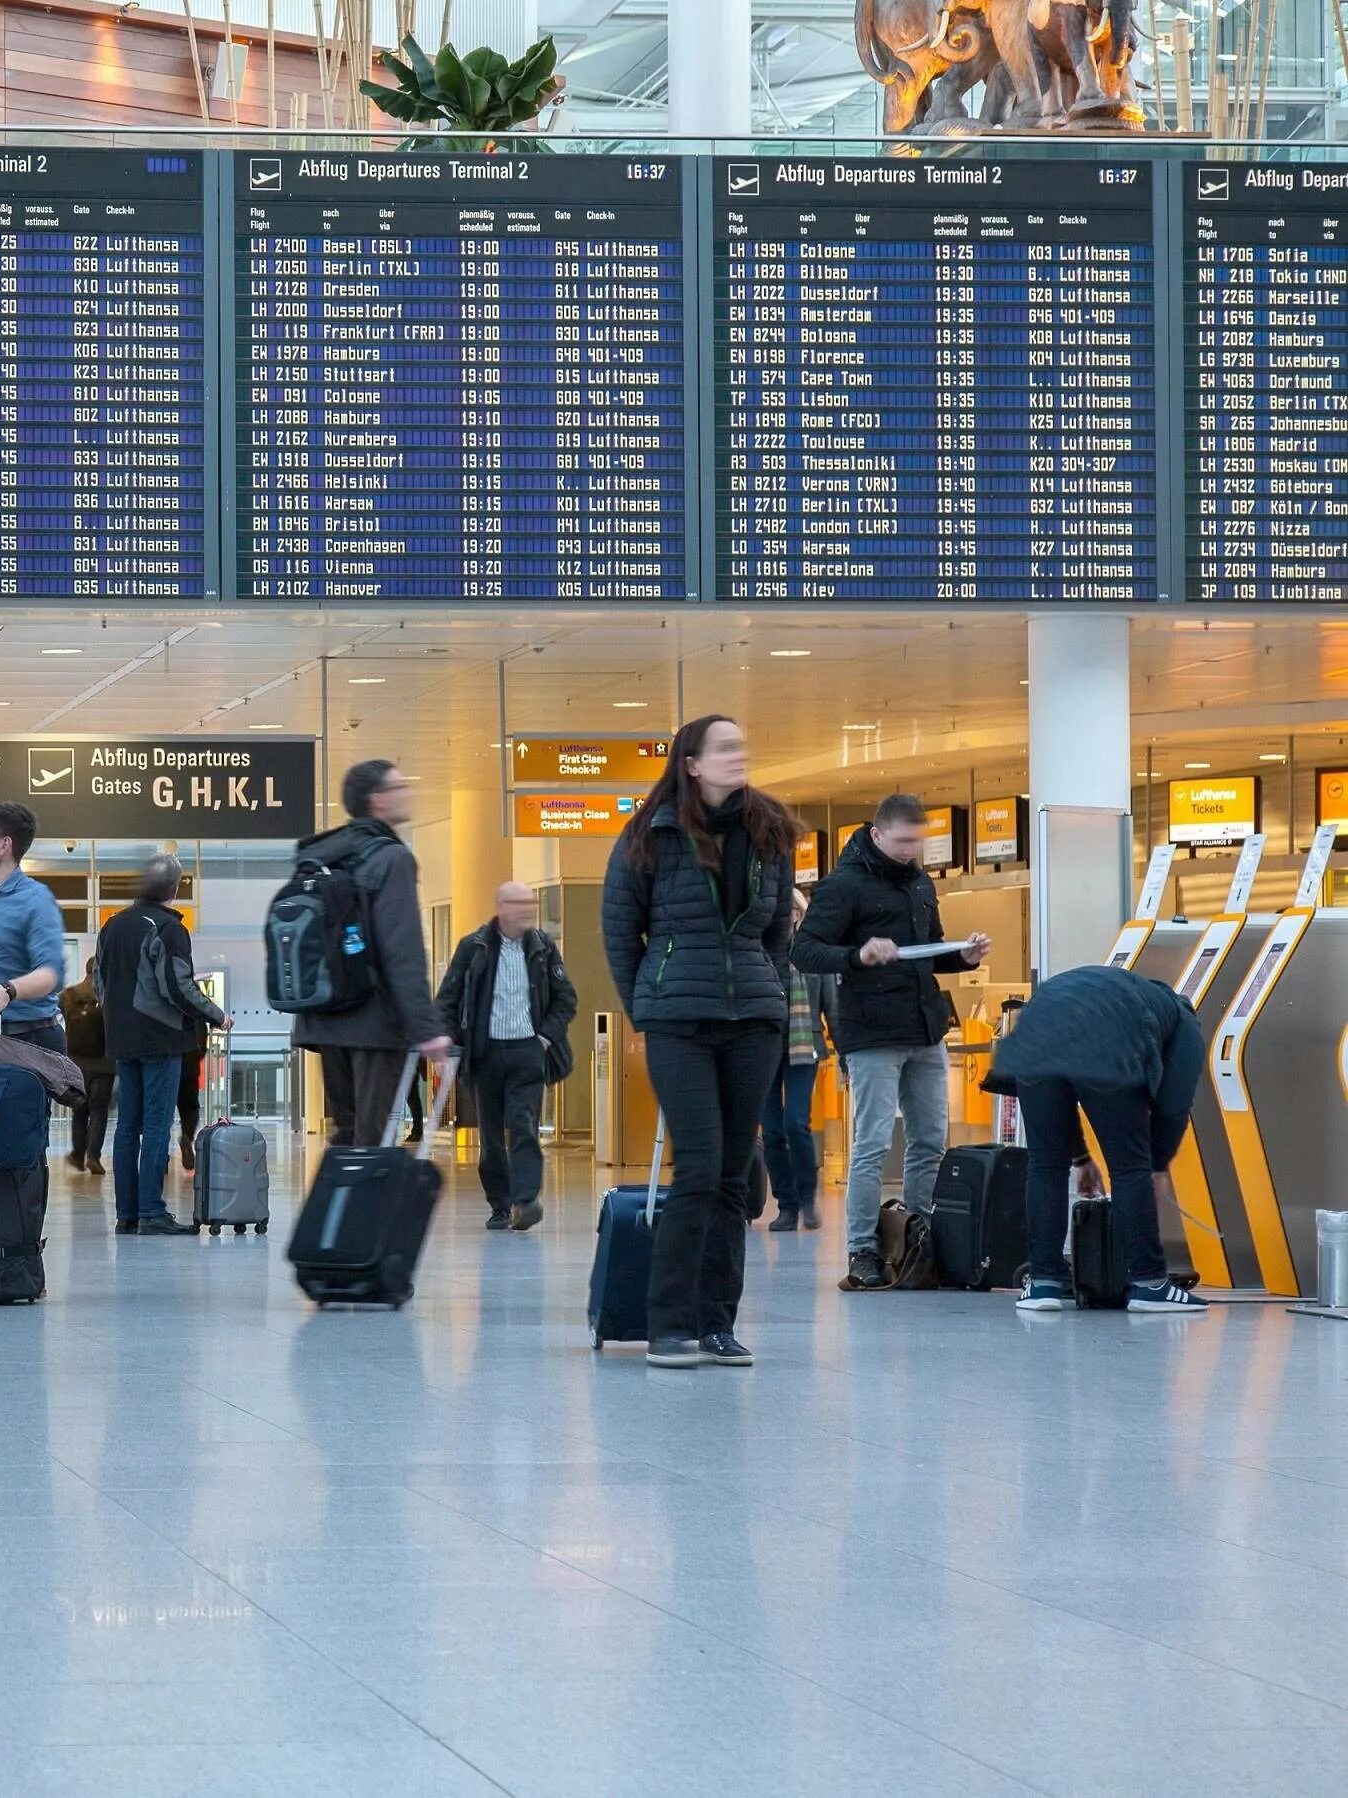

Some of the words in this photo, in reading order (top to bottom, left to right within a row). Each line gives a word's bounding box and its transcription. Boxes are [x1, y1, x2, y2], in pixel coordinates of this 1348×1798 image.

[37, 155, 47, 173] 2
[298, 159, 348, 181] Abflug
[358, 159, 441, 182] Departures
[448, 160, 513, 179] Terminal
[518, 161, 529, 179] 2
[627, 164, 666, 179] 16:37
[775, 164, 825, 186] Abflug
[834, 164, 916, 187] Departures
[923, 165, 987, 184] Terminal
[991, 166, 1002, 184] 2
[1099, 169, 1138, 184] 16:37
[1244, 169, 1294, 191] Abflug
[729, 242, 745, 258] LH
[754, 243, 785, 258] 1994
[800, 243, 856, 259] Cologne
[935, 244, 974, 260] 19:25
[1028, 245, 1052, 261] K03
[1059, 245, 1130, 261] Lufthansa
[1198, 247, 1215, 262] LH
[1223, 247, 1254, 262] 1706
[1268, 247, 1308, 263] Sofia
[73, 278, 99, 294] K10
[106, 279, 179, 295] Lufthansa
[1200, 436, 1216, 452] LH
[1224, 436, 1255, 452] 1806
[1270, 437, 1317, 452] Madrid
[252, 495, 269, 510] LH
[278, 495, 309, 510] 1616
[324, 495, 374, 511] Warsaw
[462, 496, 501, 512] 19:15
[556, 496, 580, 512] K01
[588, 496, 661, 512] Lufthansa
[1200, 520, 1217, 536] LH
[1223, 520, 1256, 536] 2276
[1270, 521, 1310, 537] Nizza
[253, 559, 269, 574] OS
[286, 559, 310, 574] 116
[325, 559, 374, 575] Vienna
[463, 560, 502, 575] 19:20
[557, 560, 582, 576] K12
[589, 560, 661, 576] Lufthansa
[559, 744, 603, 753] Lufthansa
[90, 747, 148, 771] Abflug
[153, 747, 251, 771] Departures
[559, 754, 580, 764] First
[582, 754, 607, 764] Class
[559, 765, 600, 775] Check-in
[91, 776, 142, 795] Gates
[1191, 789, 1236, 801] Lufthansa
[541, 800, 585, 809] Lufthansa
[1192, 804, 1224, 814] Tickets
[540, 811, 583, 819] Business
[584, 811, 610, 820] Class
[541, 820, 582, 830] Check-in
